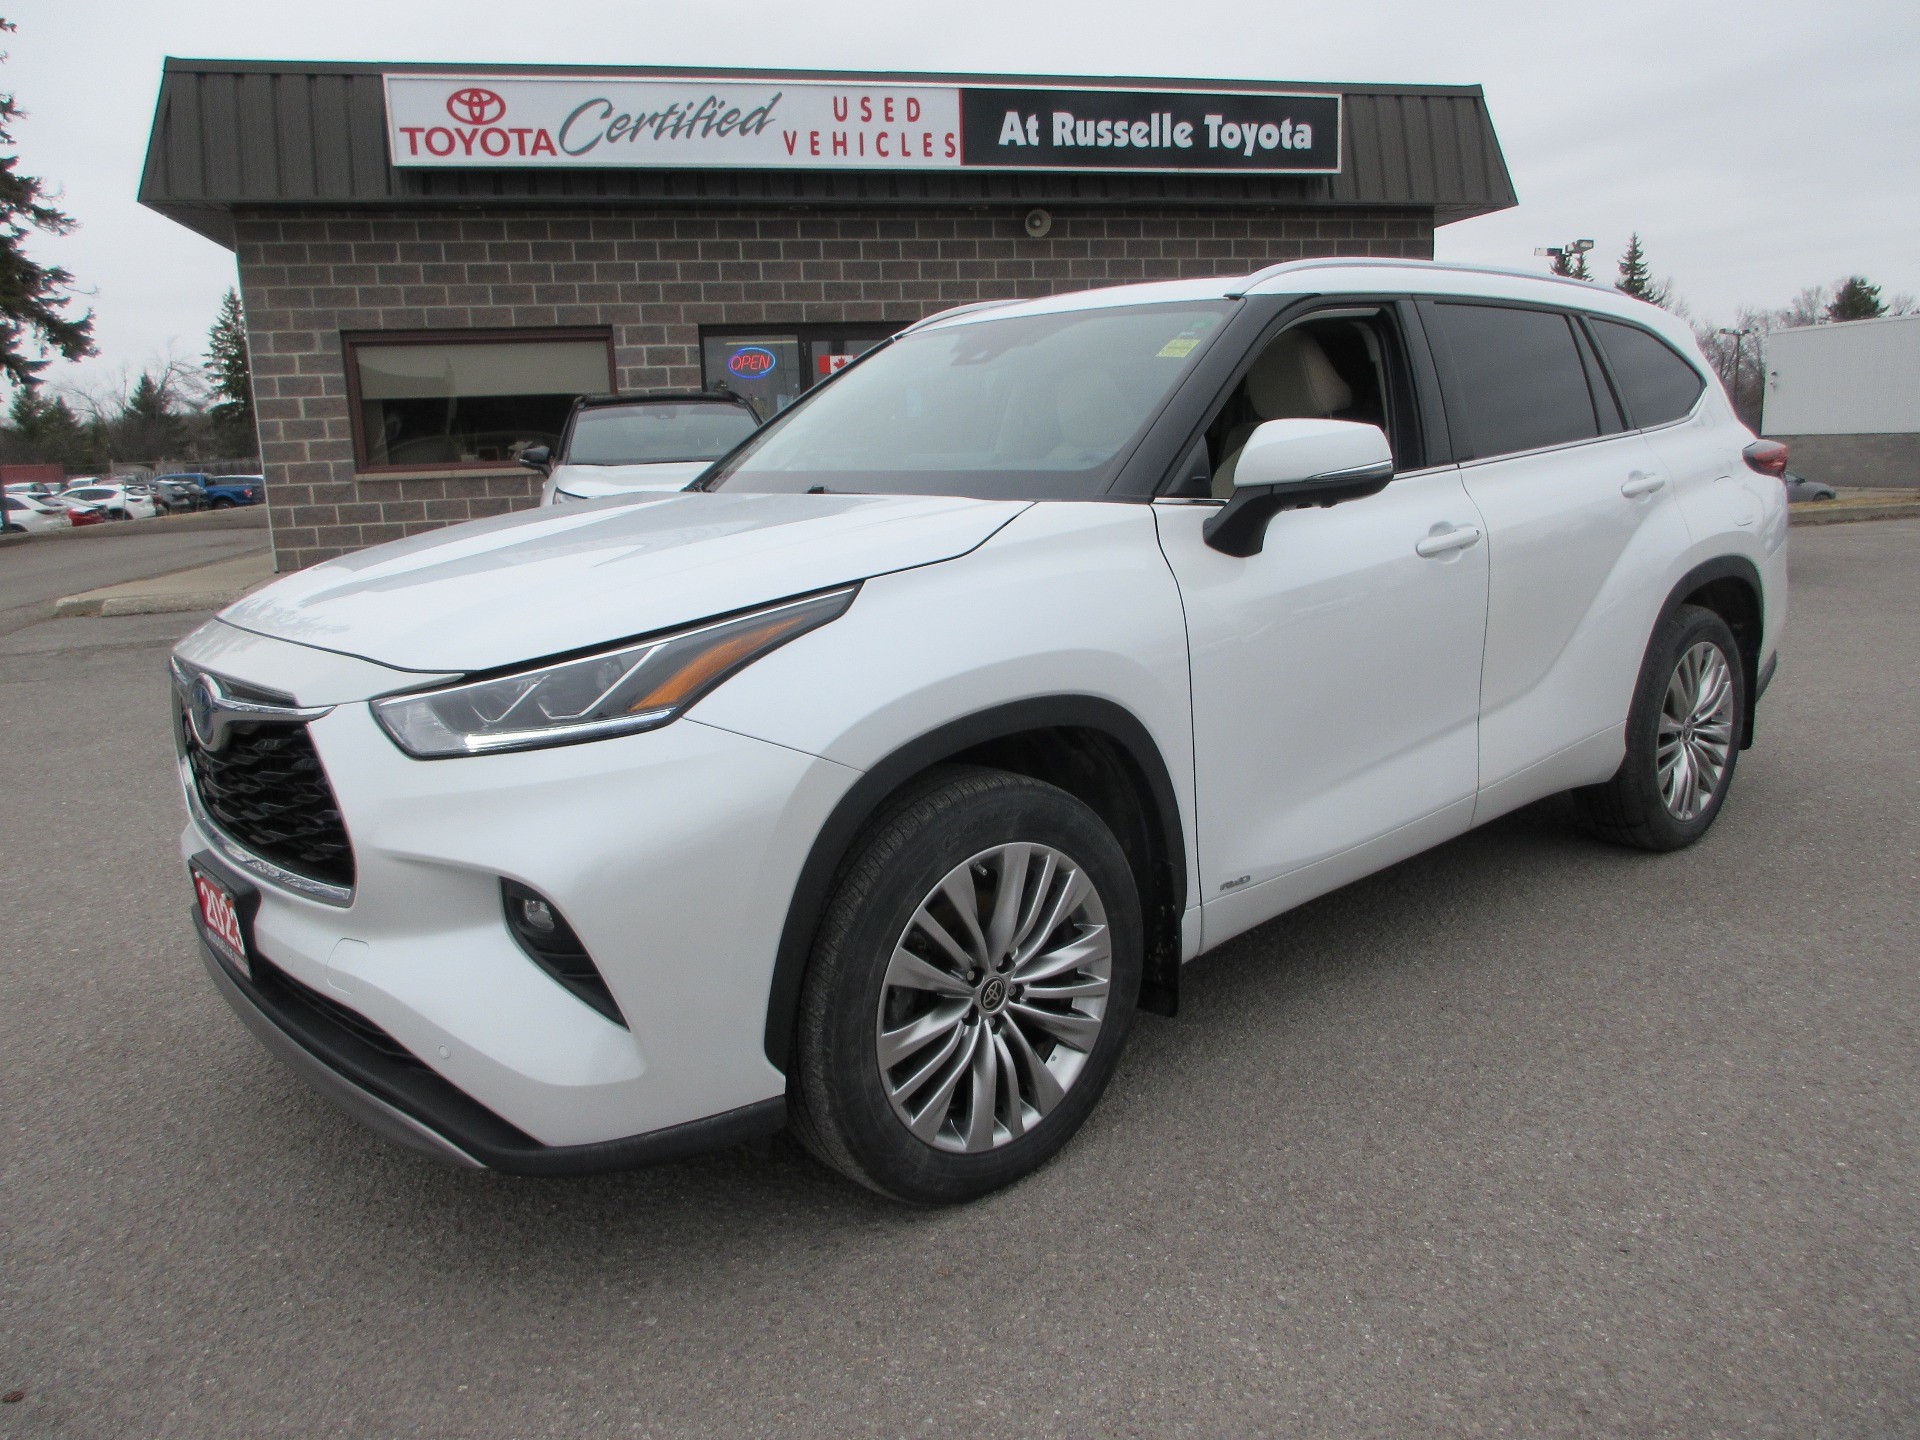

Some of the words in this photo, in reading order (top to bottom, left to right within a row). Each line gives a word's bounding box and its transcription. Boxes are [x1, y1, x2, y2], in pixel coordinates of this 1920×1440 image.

[400, 127, 558, 156] TOYOTA
[559, 91, 783, 157] Certified
[833, 96, 921, 123] USED
[783, 130, 957, 158] VEHICLES
[998, 111, 1039, 146] At
[1052, 112, 1193, 148] Russelle
[1204, 114, 1312, 157] Toyota
[730, 354, 771, 371] OPEN
[200, 881, 246, 956] 2023
